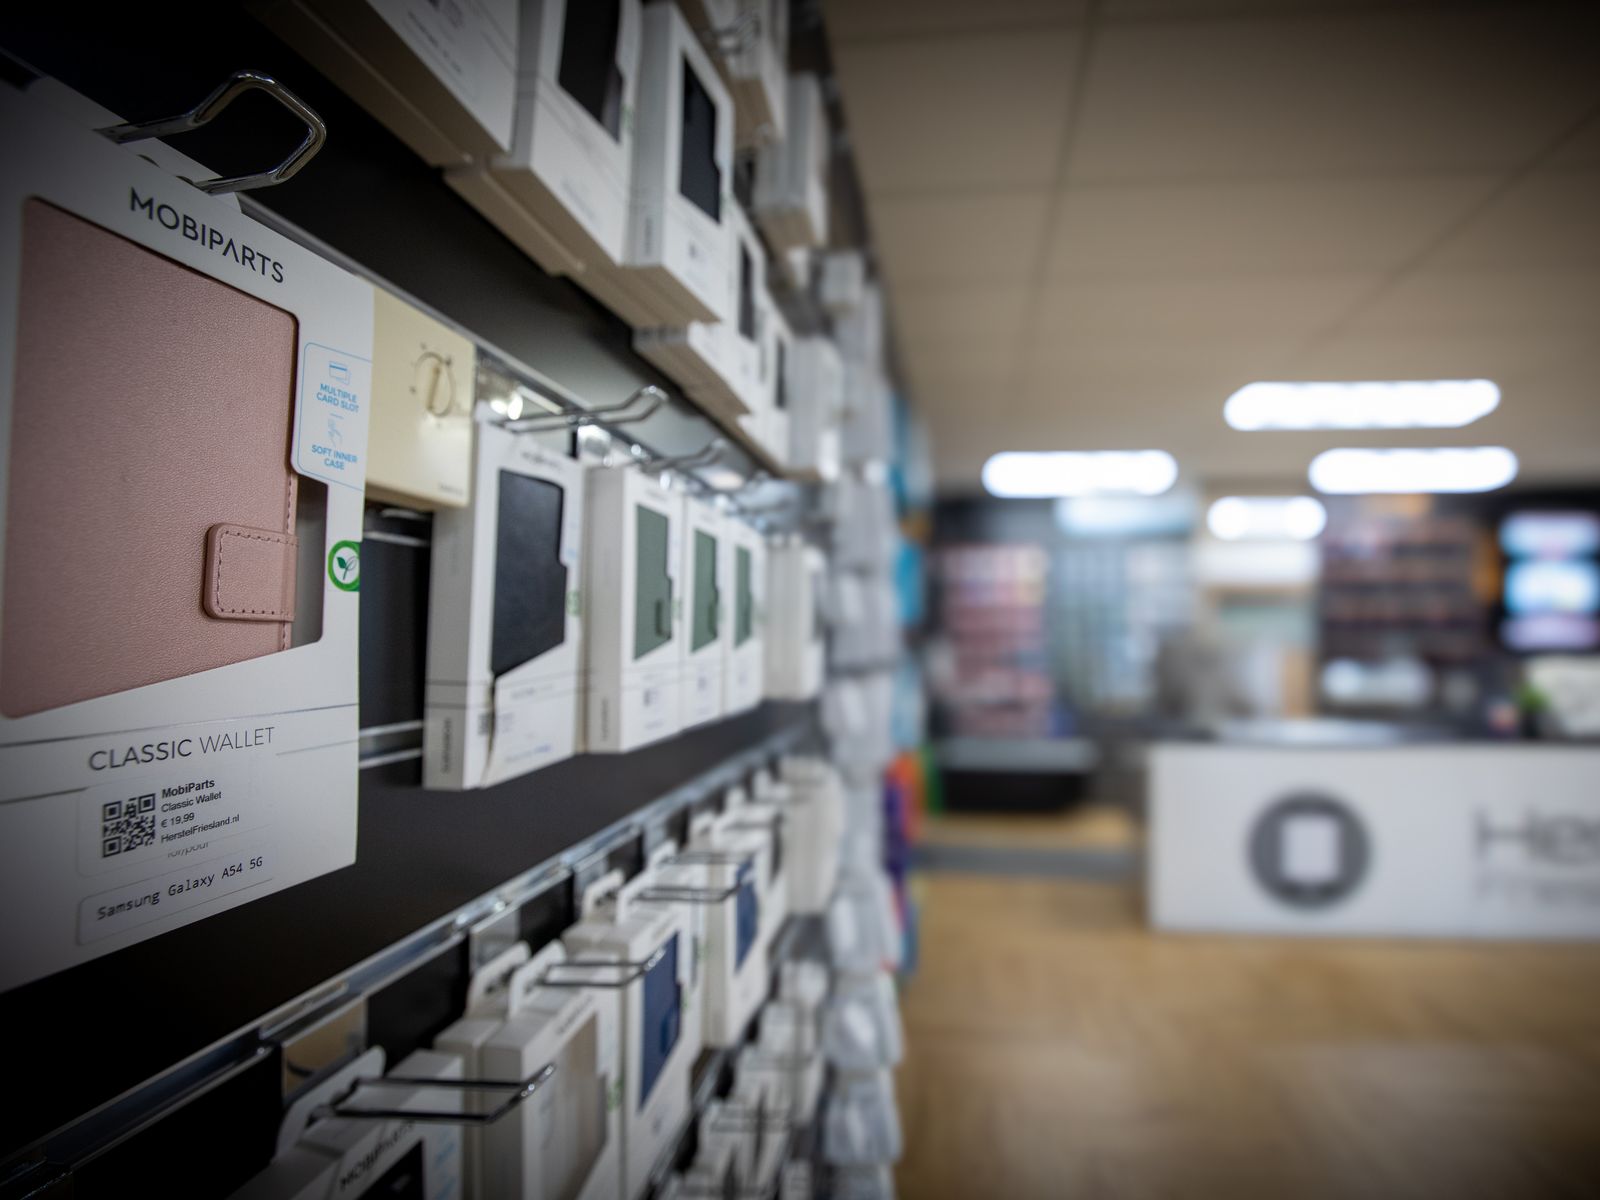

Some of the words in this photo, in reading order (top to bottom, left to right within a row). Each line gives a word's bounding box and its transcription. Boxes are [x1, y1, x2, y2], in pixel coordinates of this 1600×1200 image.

[130, 187, 284, 283] MOBIPARTS
[316, 392, 339, 406] CARD
[341, 401, 359, 413] SLOT
[320, 383, 358, 403] MULTIPLE
[311, 444, 332, 457] SOFT
[334, 450, 358, 463] INNER
[323, 457, 345, 470] CASE
[89, 739, 192, 771] CLASSIC
[200, 727, 275, 754] WALLET
[161, 778, 215, 799] MobiParts
[161, 797, 194, 813] Classic
[196, 791, 222, 805] Wallet
[160, 818, 168, 828] €
[161, 814, 240, 844] HerstelFriesland.nl
[97, 890, 160, 921] Samsung
[168, 874, 215, 897] Galaxy
[221, 862, 243, 879] A54
[249, 856, 263, 870] 5G
